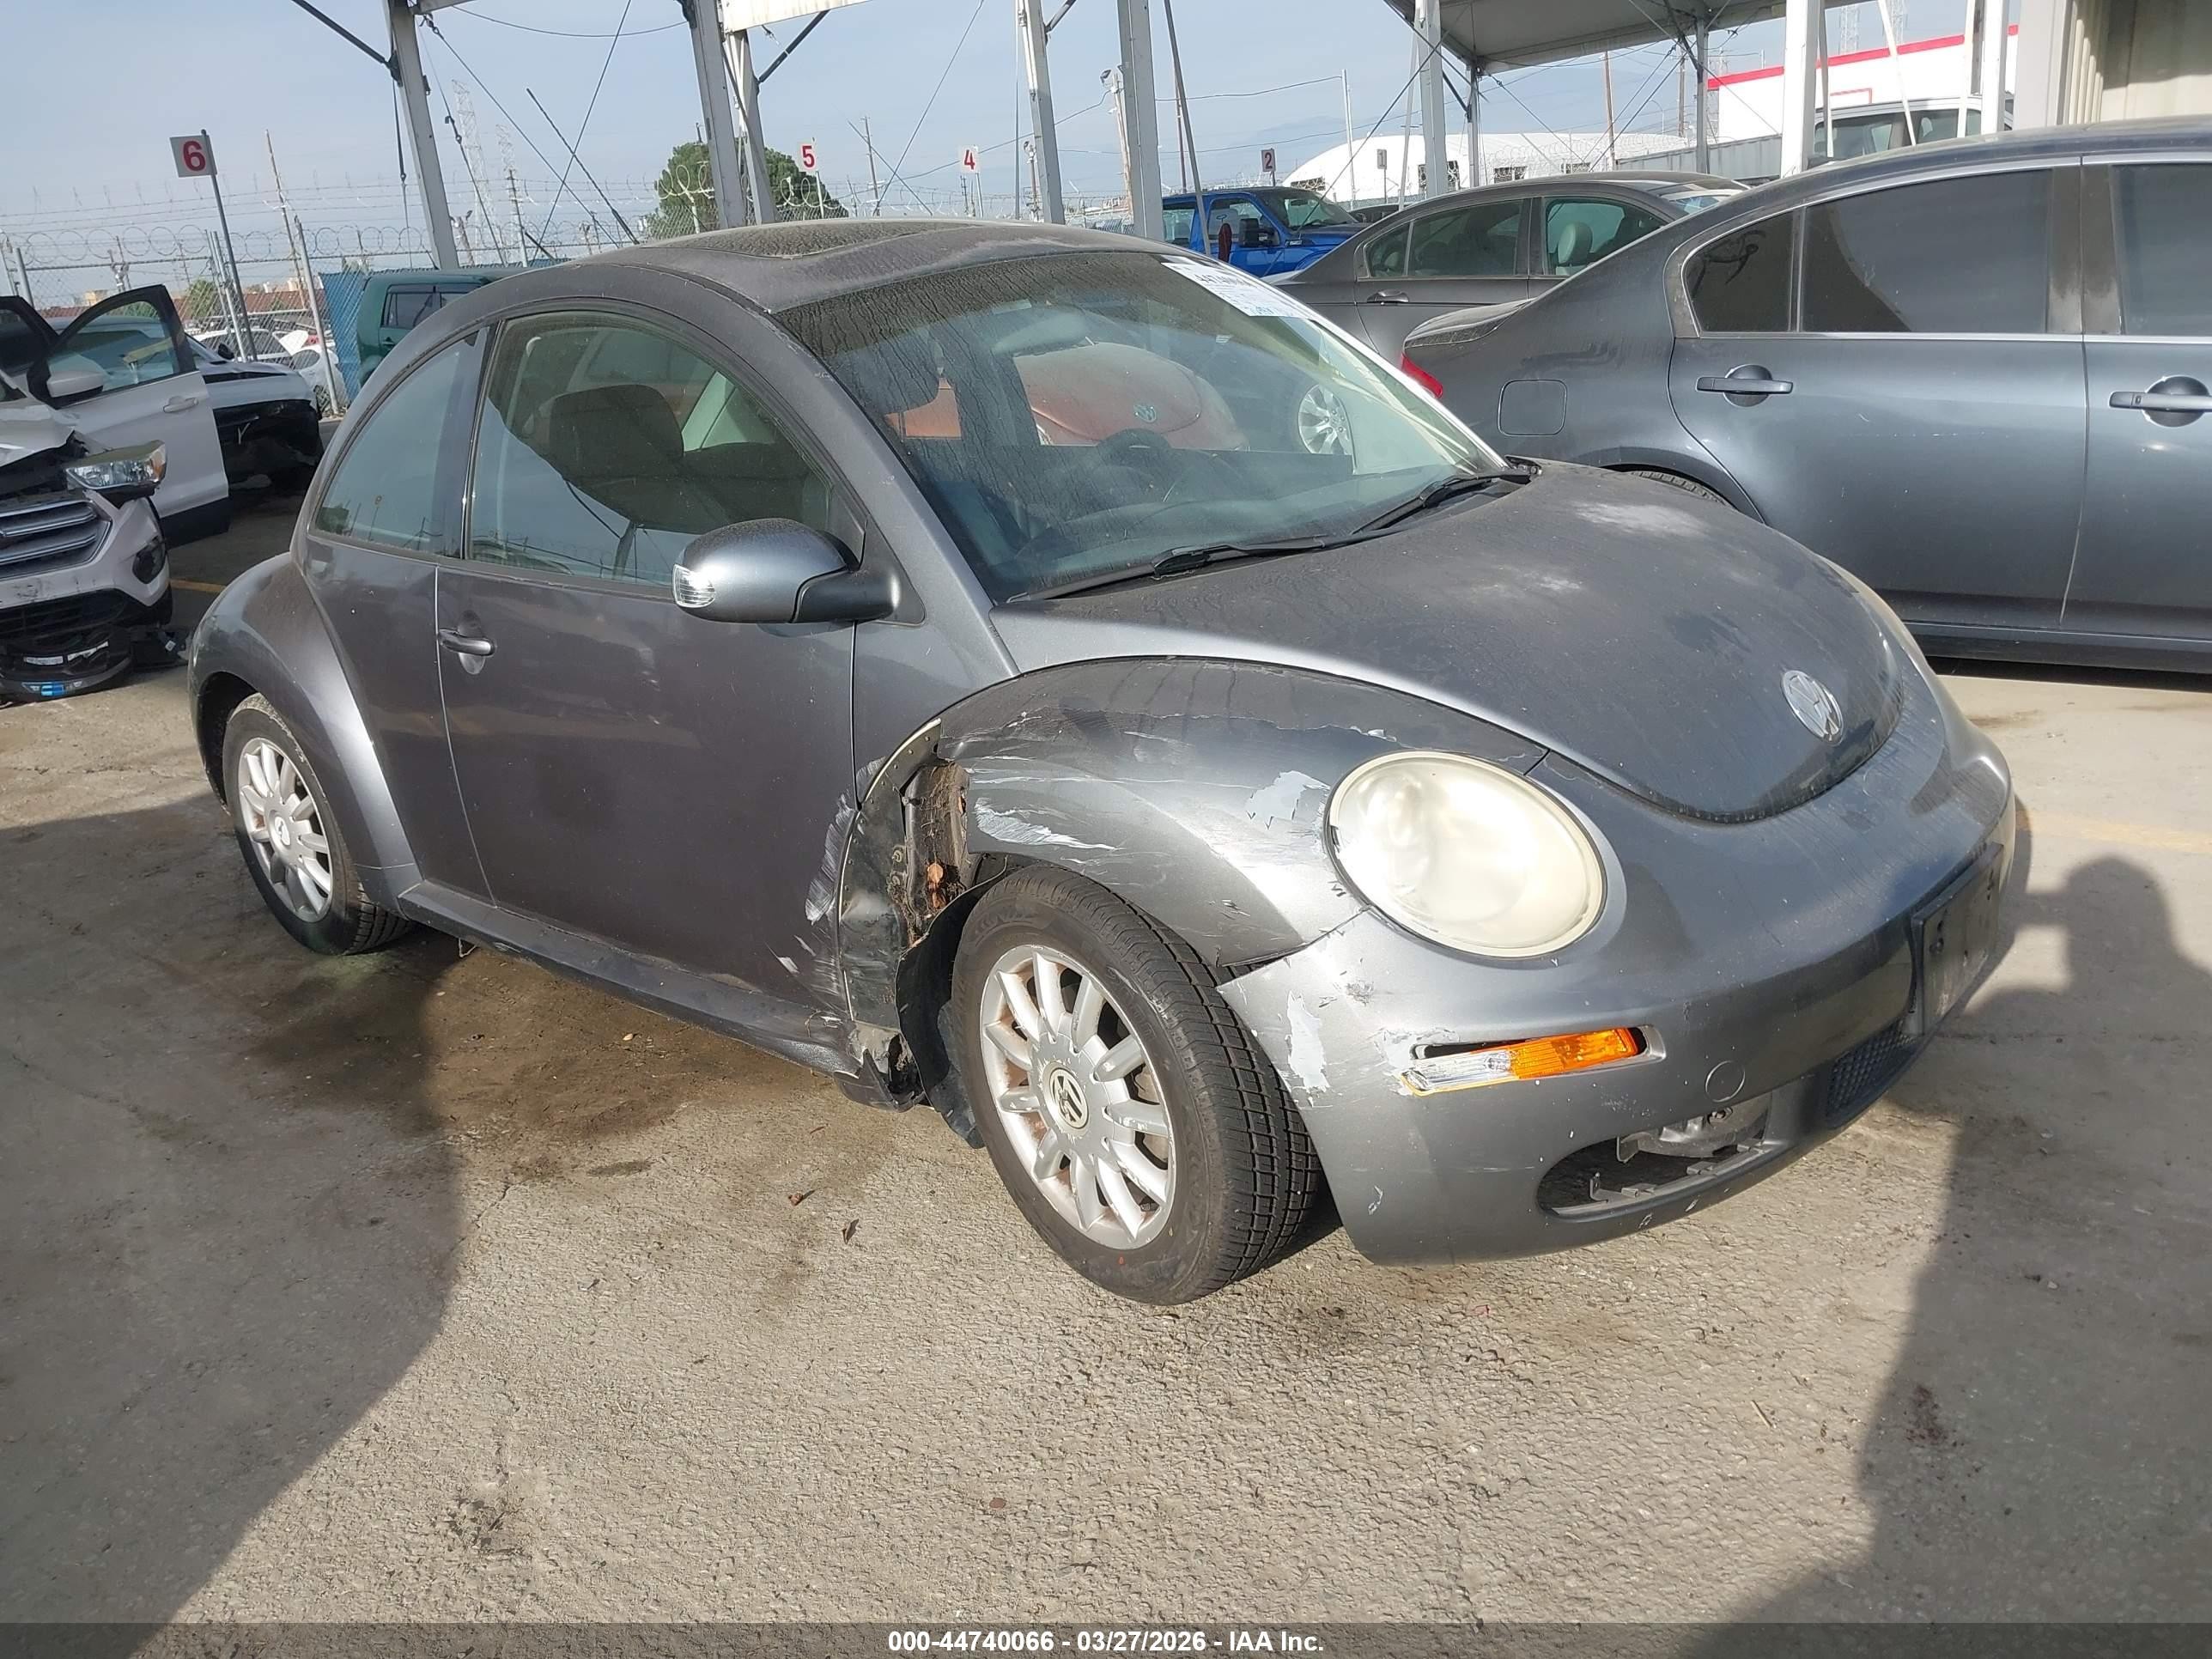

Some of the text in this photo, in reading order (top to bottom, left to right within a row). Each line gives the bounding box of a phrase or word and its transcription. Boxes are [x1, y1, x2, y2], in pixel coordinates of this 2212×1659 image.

[183, 140, 206, 172] 6
[802, 145, 815, 167] 5
[963, 149, 975, 170] 4
[1264, 152, 1273, 169] 2
[1379, 151, 1386, 167] 1
